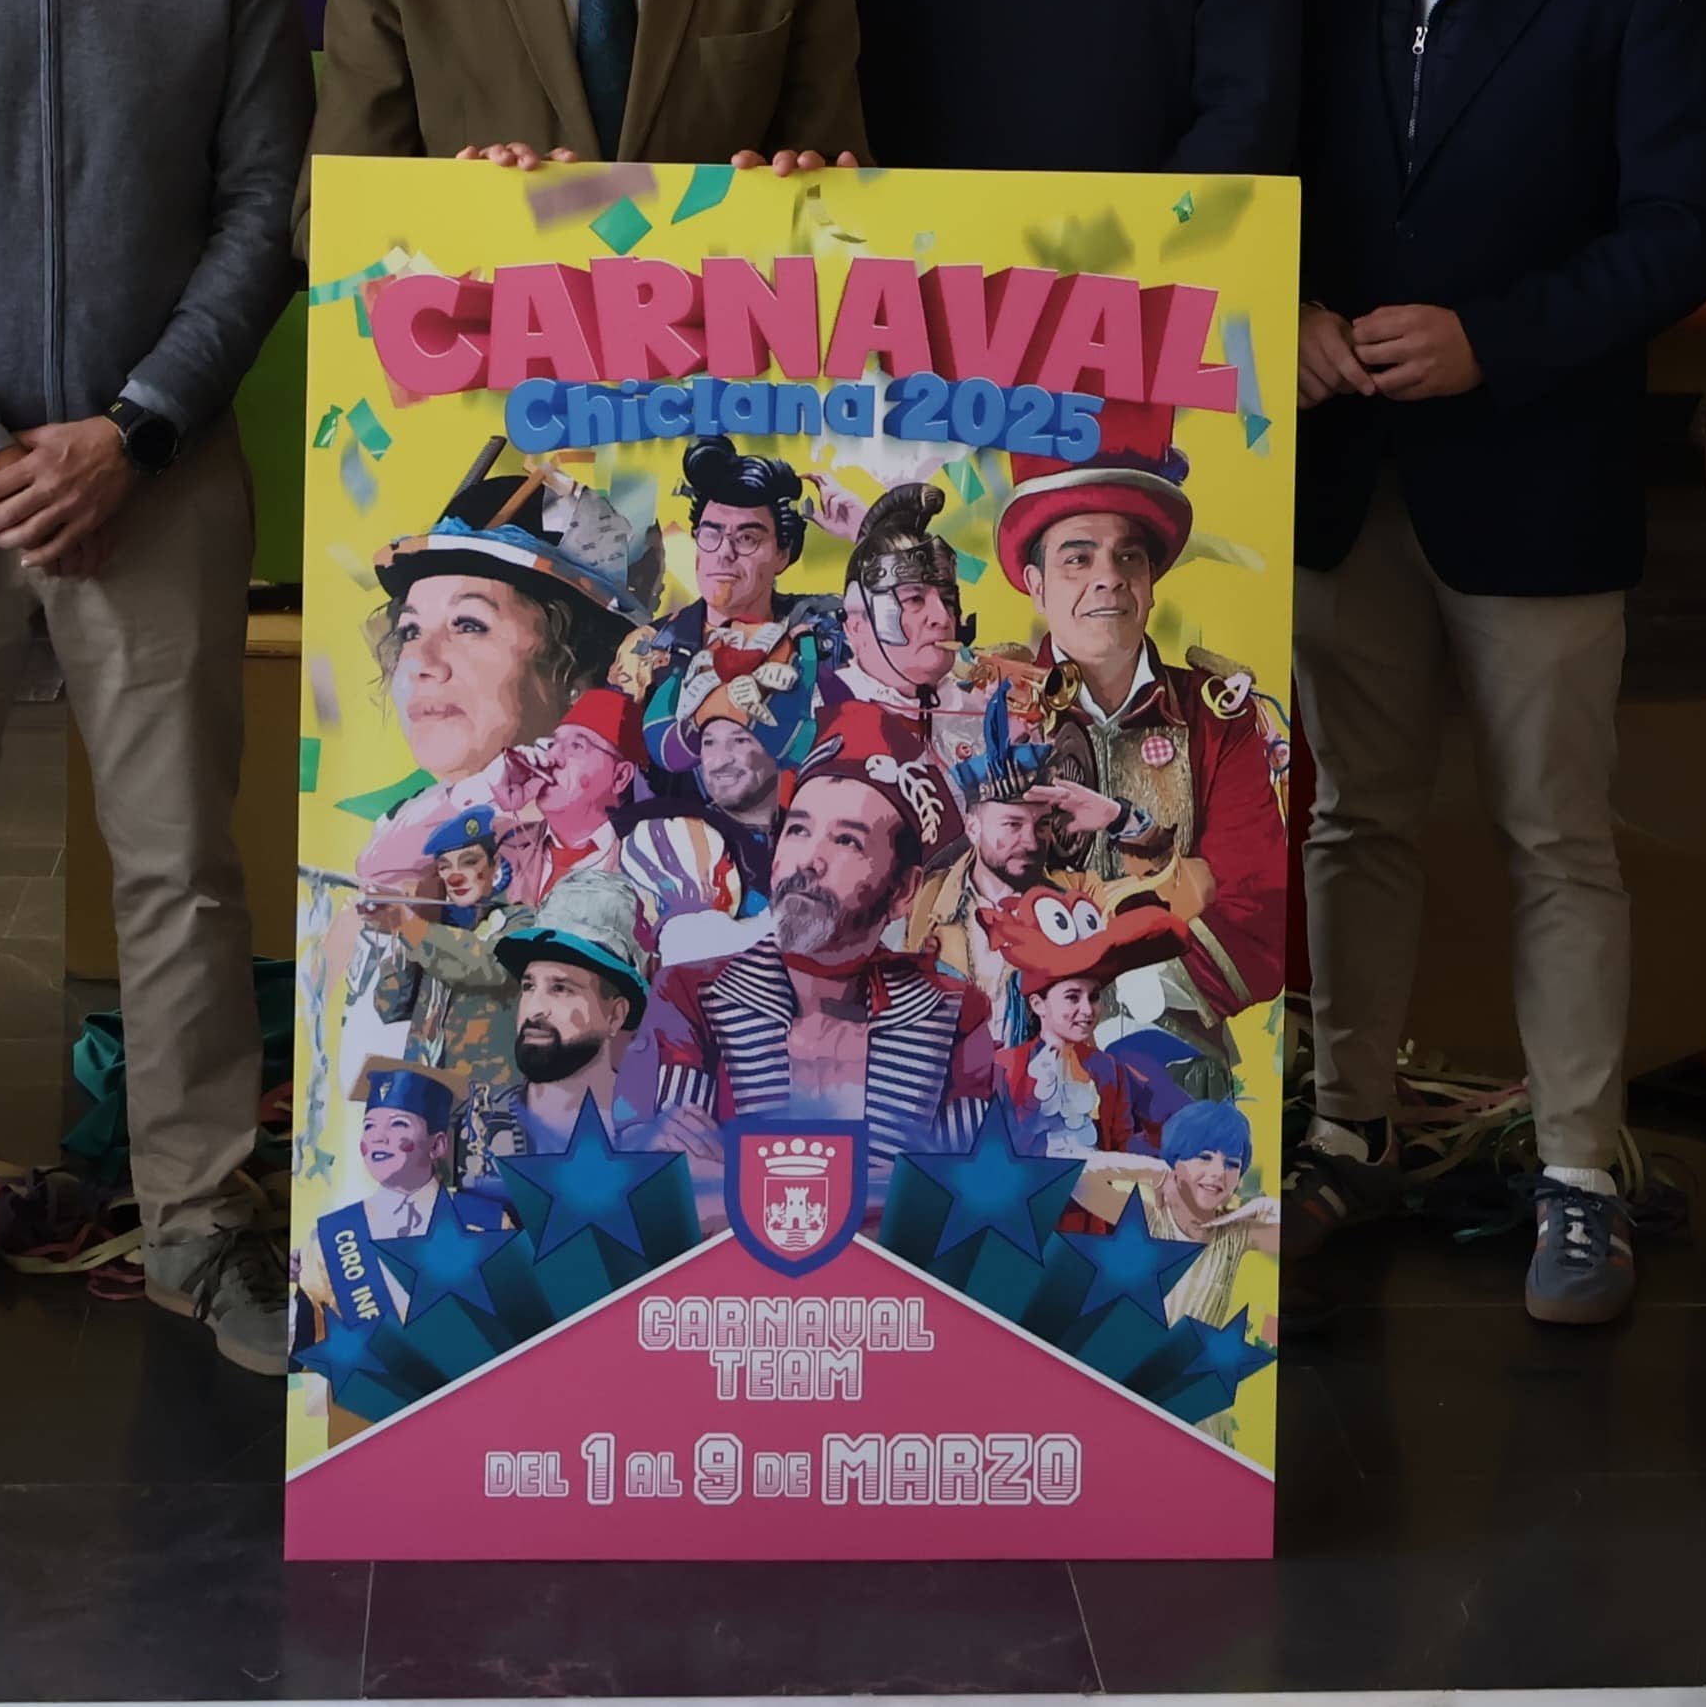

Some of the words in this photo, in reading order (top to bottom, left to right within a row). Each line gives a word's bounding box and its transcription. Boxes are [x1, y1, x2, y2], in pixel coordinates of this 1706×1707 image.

[371, 255, 1239, 413] CARNAVAL
[504, 378, 877, 454] Chiclana
[883, 371, 1104, 462] 2025
[333, 1229, 366, 1281] CORO
[636, 1295, 935, 1353] CARNAVAL
[709, 1347, 862, 1401] TEAM
[483, 1448, 569, 1499] DEL
[581, 1433, 615, 1504] 1
[625, 1452, 683, 1499] AL
[694, 1432, 745, 1504] 9
[753, 1452, 812, 1500] DE
[820, 1432, 1083, 1506] MARZO
